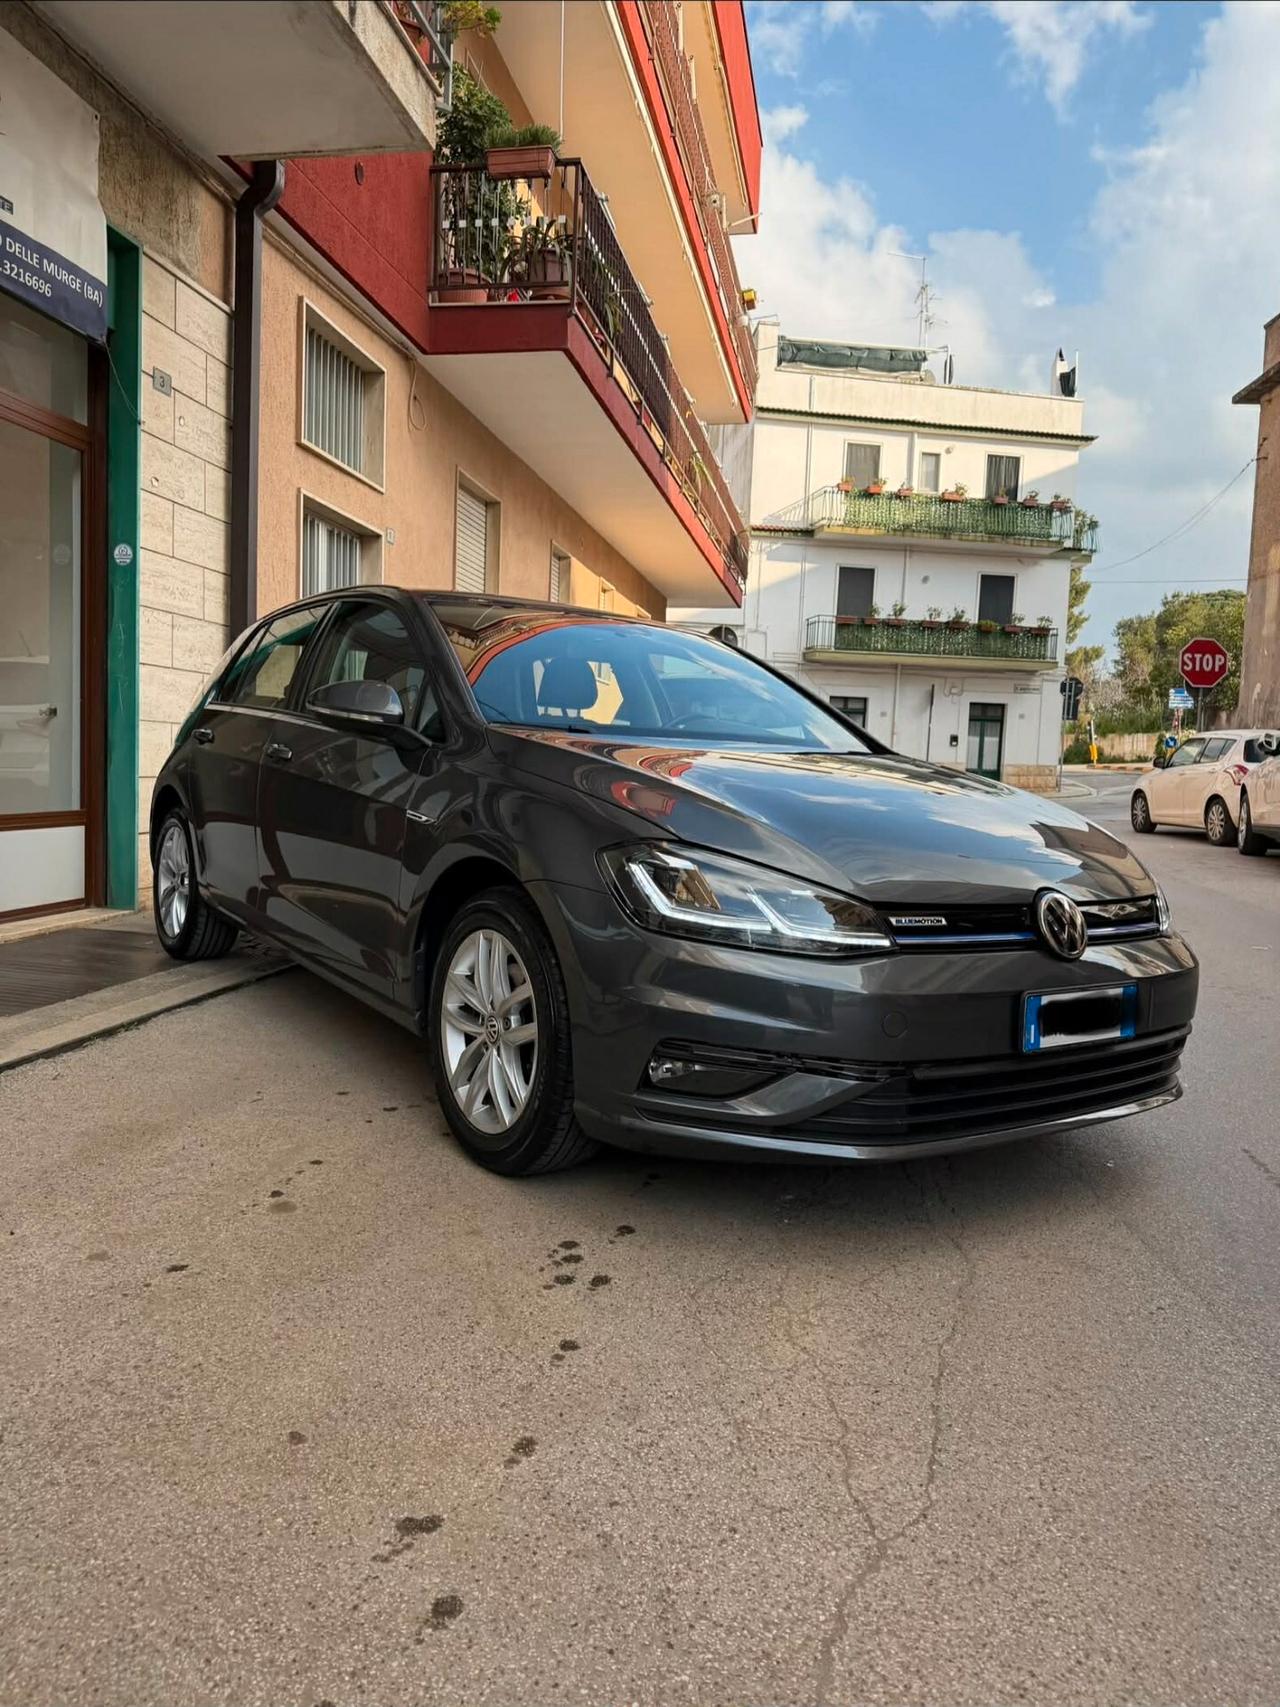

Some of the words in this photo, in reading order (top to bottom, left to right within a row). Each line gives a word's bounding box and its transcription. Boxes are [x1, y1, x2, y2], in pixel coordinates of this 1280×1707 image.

[6, 237, 39, 268] DELLE
[43, 258, 82, 293] MURGE
[83, 281, 103, 308] (BA)
[159, 375, 165, 388] 3
[1183, 653, 1225, 672] STOP
[895, 918, 943, 926] BLUEMOTION
